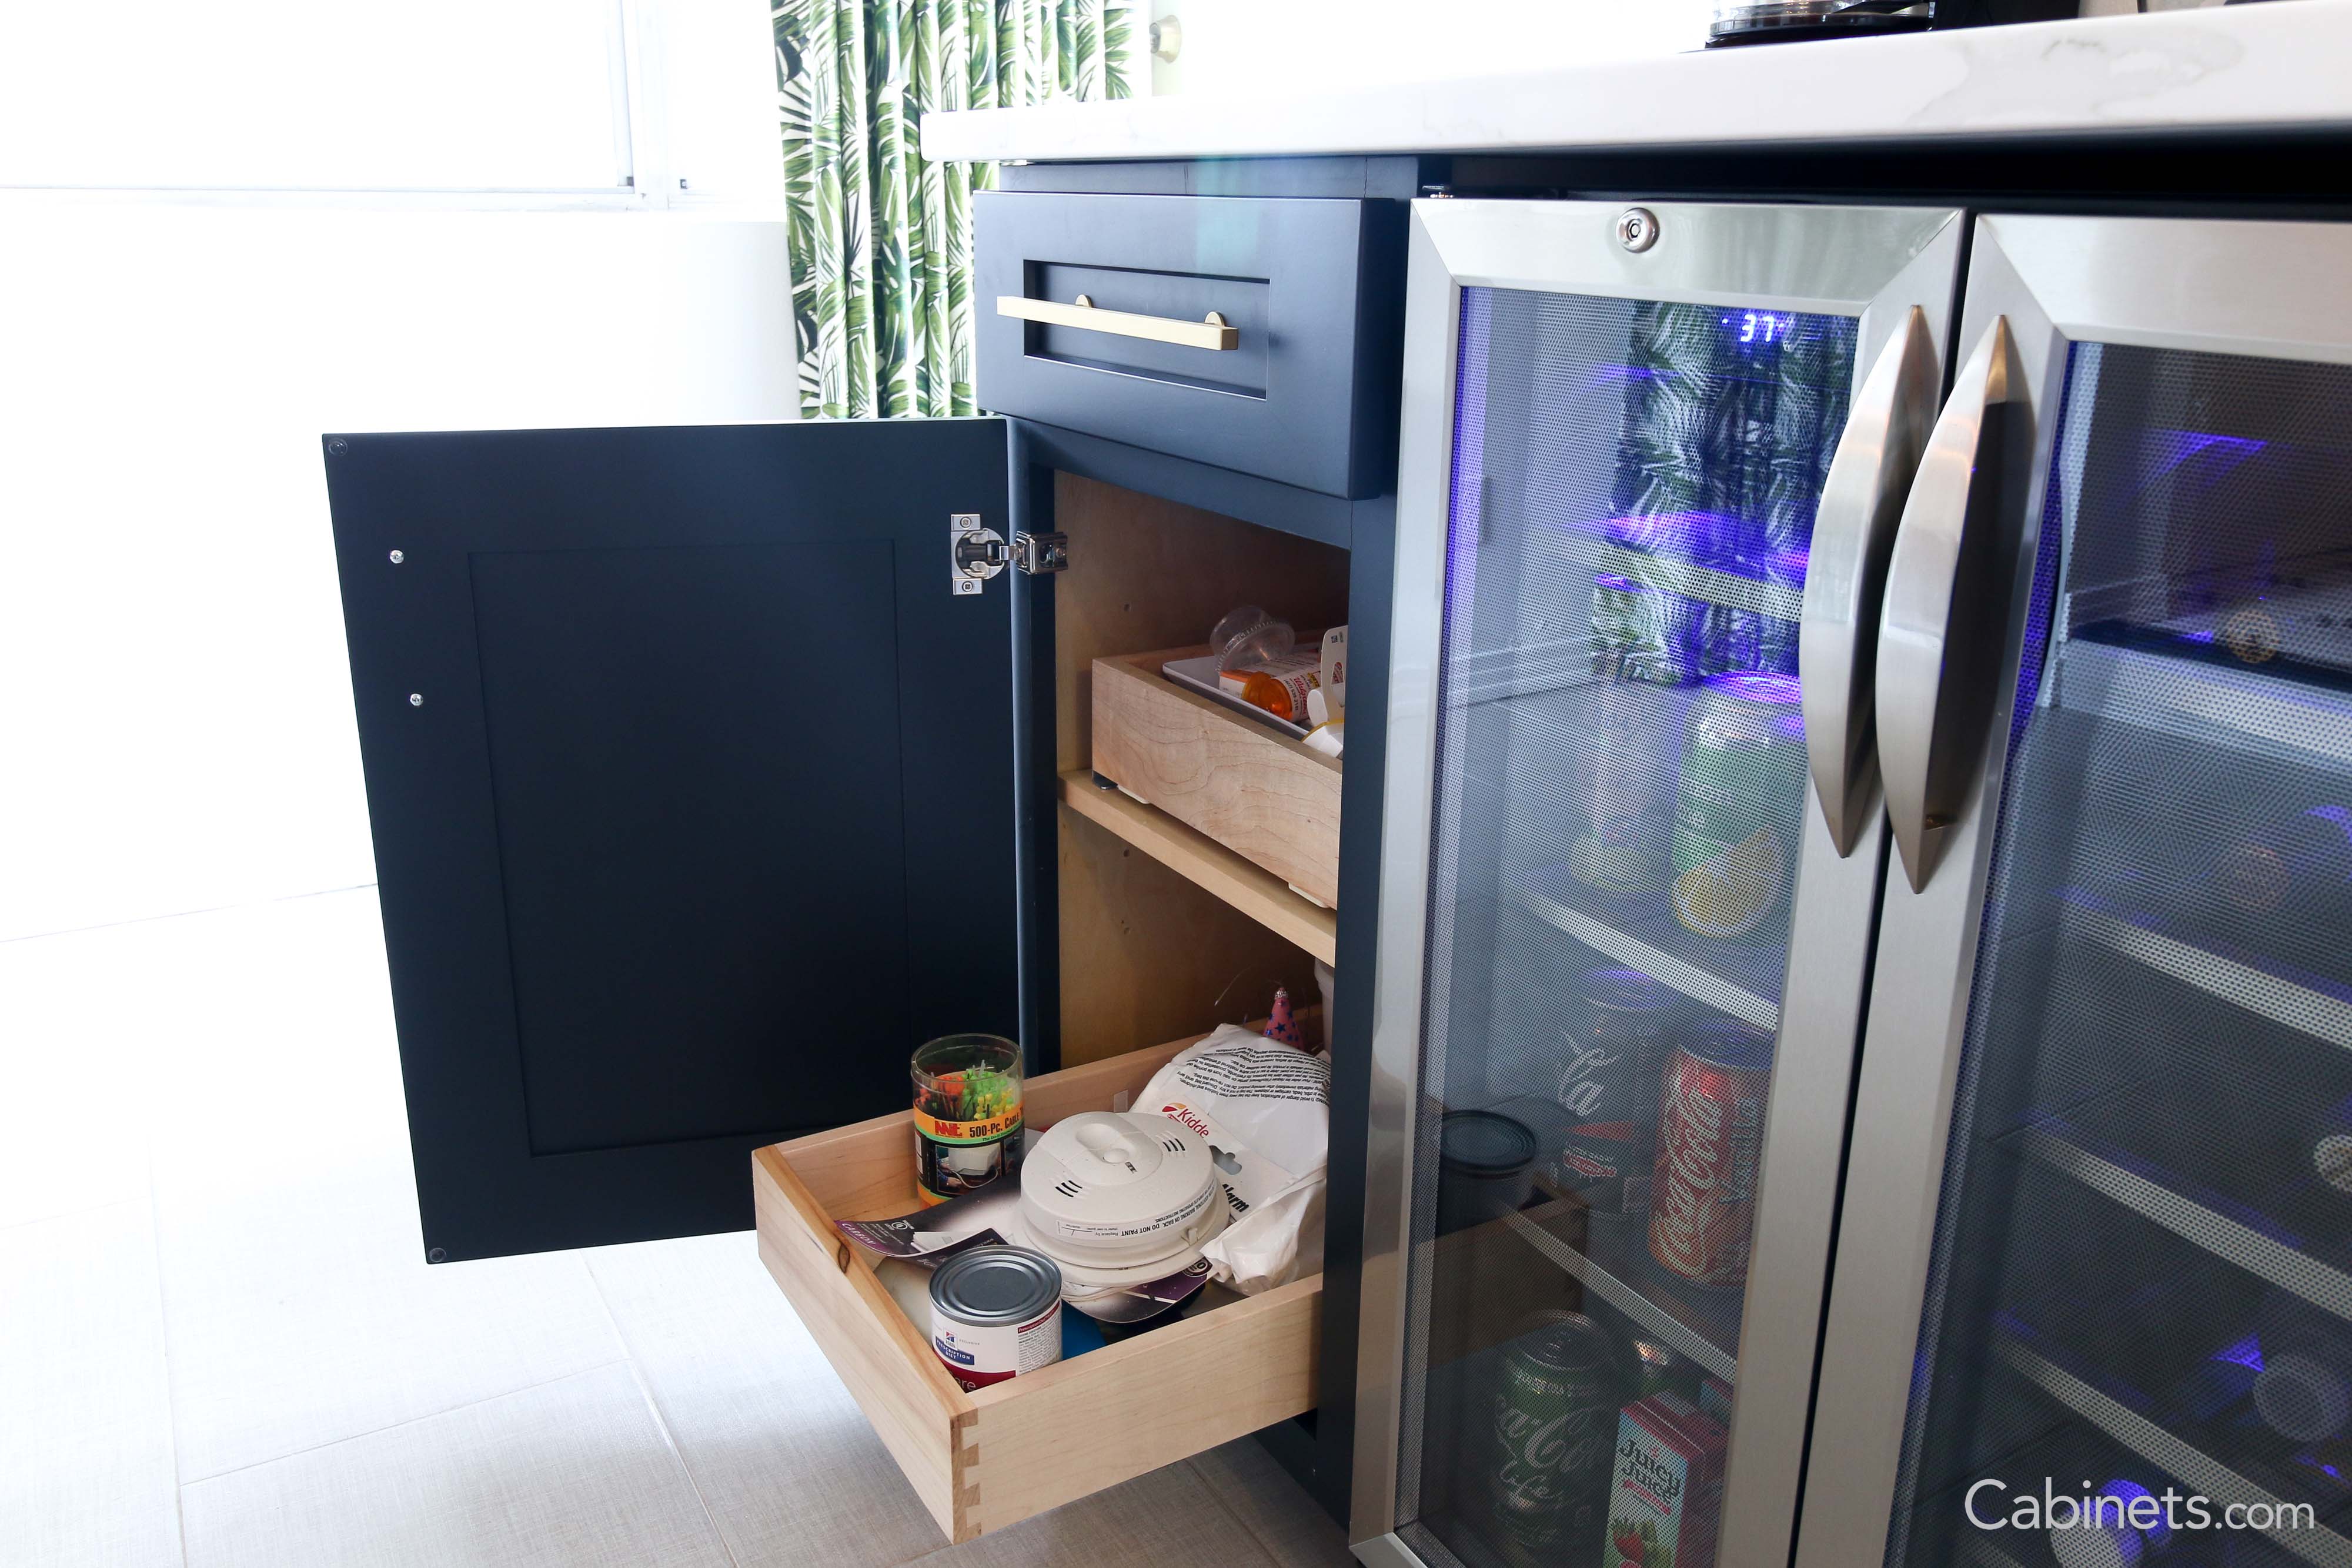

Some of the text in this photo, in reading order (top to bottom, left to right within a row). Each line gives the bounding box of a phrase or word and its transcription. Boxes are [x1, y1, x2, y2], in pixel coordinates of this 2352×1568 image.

[1740, 314, 1775, 343] 37
[1177, 1108, 1208, 1138] Kidde
[1180, 1208, 1195, 1220] MARKING
[937, 1339, 970, 1360] PRESCRIPTION
[946, 1351, 956, 1359] DIET
[1619, 1439, 1681, 1498] Juicy
[1622, 1460, 1672, 1505] Juice
